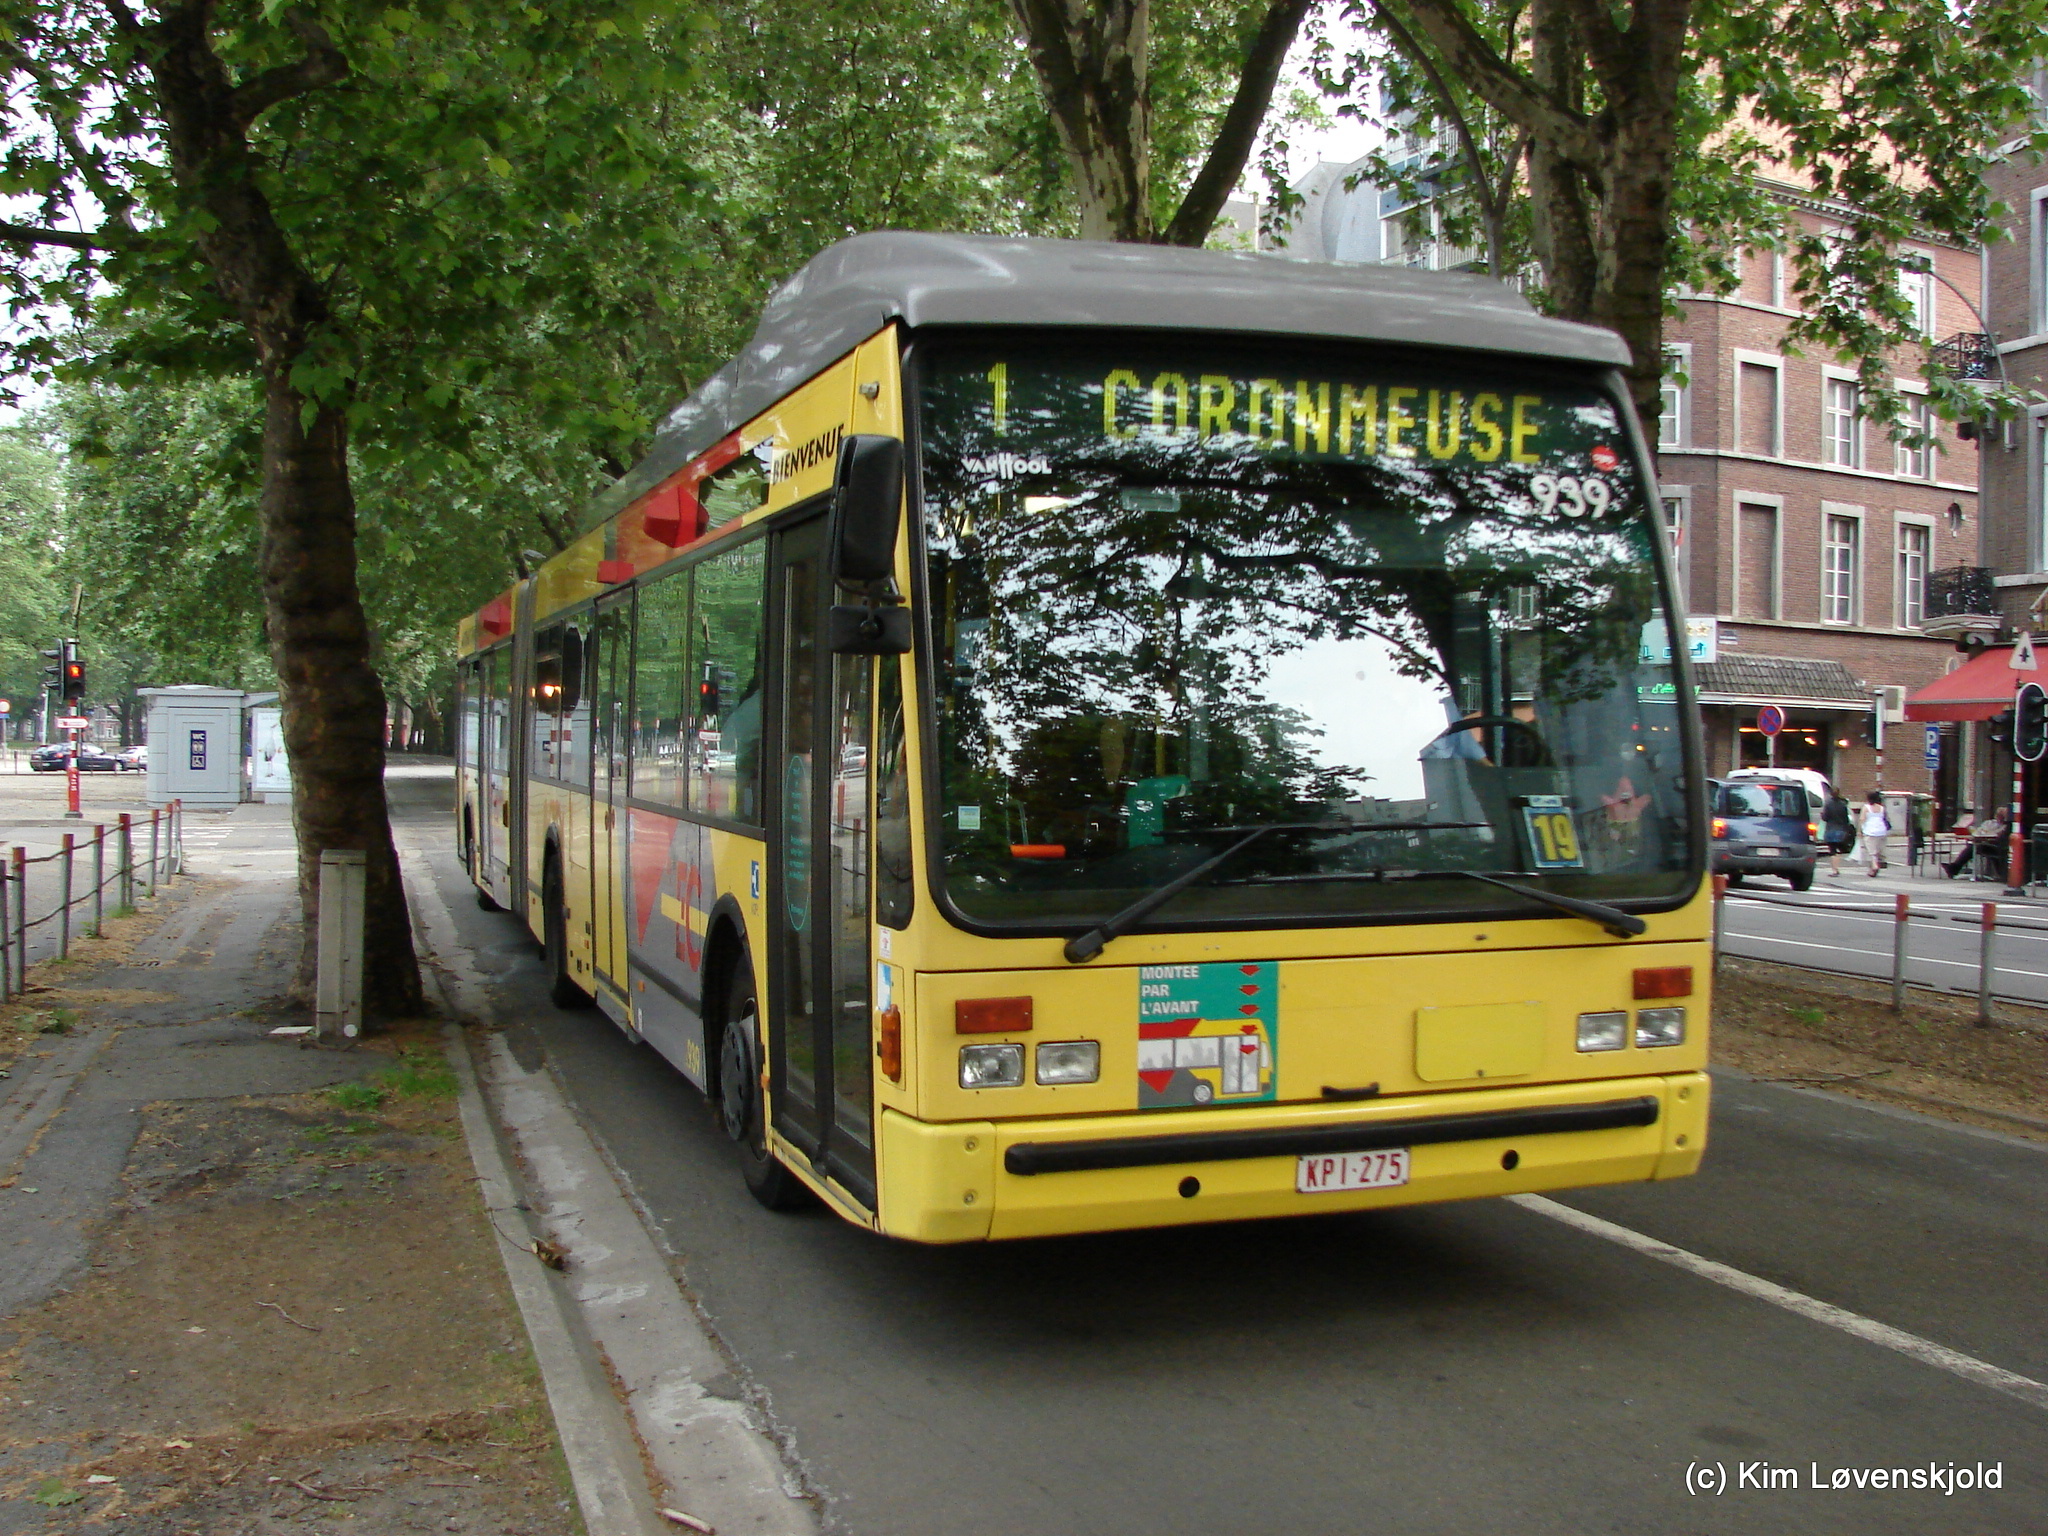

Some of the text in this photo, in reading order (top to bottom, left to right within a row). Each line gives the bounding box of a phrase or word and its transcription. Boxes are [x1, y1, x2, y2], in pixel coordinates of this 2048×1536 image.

[987, 362, 1542, 464] 1 CORONMEUSE
[1530, 474, 1611, 519] 939
[1533, 814, 1578, 861] 19
[1141, 965, 1200, 980] MONTEE
[1141, 984, 1170, 997] PAR
[1141, 1000, 1200, 1016] L'AVANT
